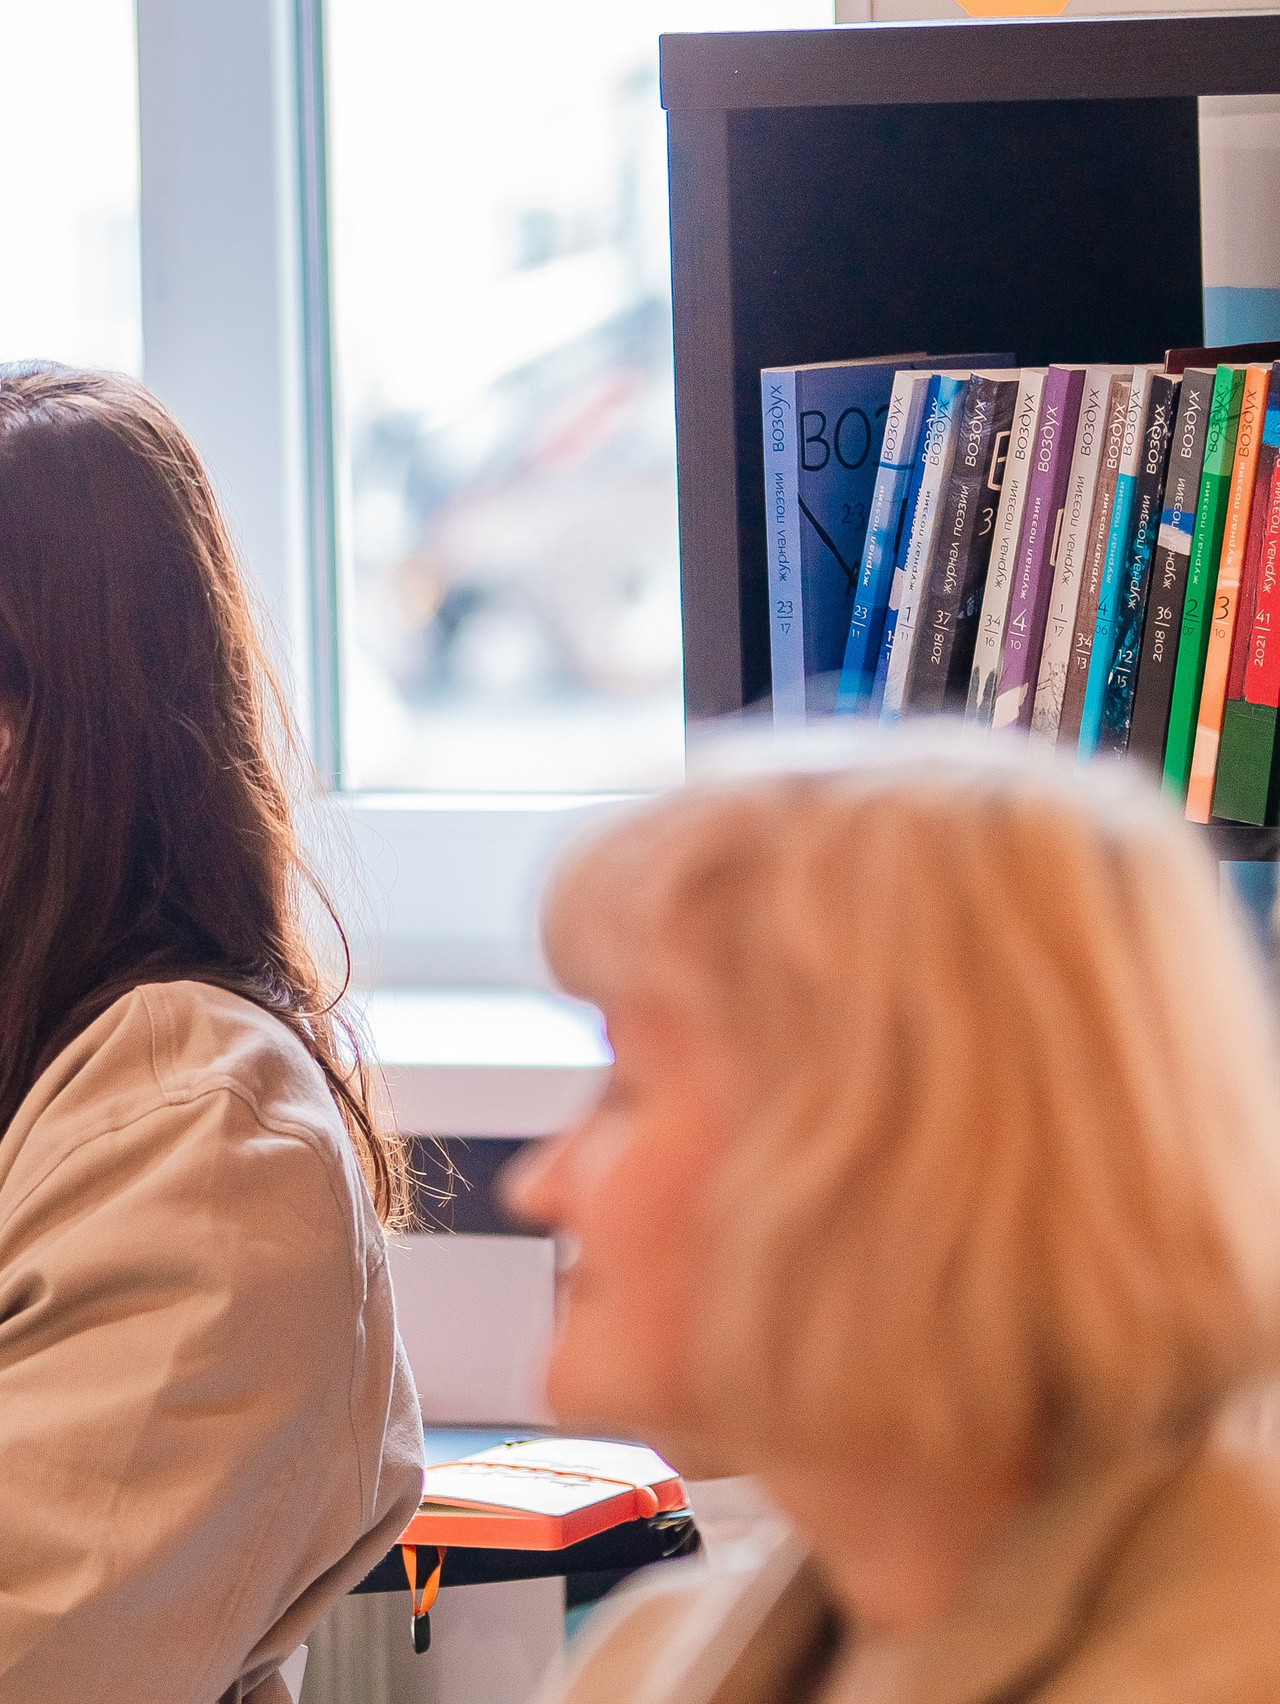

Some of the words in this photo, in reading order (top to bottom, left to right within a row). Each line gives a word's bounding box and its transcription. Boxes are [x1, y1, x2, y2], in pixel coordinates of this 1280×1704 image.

[775, 472, 786, 524] поэзии
[863, 536, 876, 586] журнал
[873, 486, 885, 532] поэзии
[909, 542, 922, 591] журнал
[919, 491, 931, 537] поэзии
[943, 542, 959, 594] журнал
[953, 486, 970, 537] поэзии
[995, 537, 1010, 589] журнал
[1004, 480, 1019, 530] поэзии
[1062, 534, 1076, 585] журнал
[1071, 475, 1085, 527] поэзии
[1089, 543, 1102, 593] журнал
[1099, 493, 1110, 539] поэзии
[1163, 538, 1177, 589] журна
[1171, 478, 1186, 530] поэзии
[1193, 534, 1204, 584] журнал
[1201, 481, 1211, 527] поэзии
[1263, 540, 1277, 593] журнал
[1270, 481, 1280, 534] поэзии
[778, 530, 790, 582] журнал
[1020, 549, 1034, 600] журнал
[1029, 497, 1041, 544] поэзии
[1128, 555, 1142, 609] журнал
[1136, 495, 1151, 549] поэзии
[934, 610, 952, 625] 37
[1012, 609, 1027, 632] 4
[1098, 595, 1108, 616] 4
[1156, 606, 1172, 620] 36
[1185, 599, 1199, 617] 2
[1216, 596, 1229, 619] 3
[1256, 609, 1270, 624] 41
[781, 623, 790, 634] 17
[985, 637, 995, 647] 16
[1054, 625, 1064, 637] 17
[1215, 629, 1225, 638] 10
[931, 633, 945, 665] 2018
[1011, 640, 1021, 650] 10
[1118, 649, 1133, 664] 1-2
[1153, 630, 1165, 662] 2018
[1254, 635, 1266, 667] 2021
[1077, 657, 1087, 669] 13
[1117, 675, 1127, 688] 15
